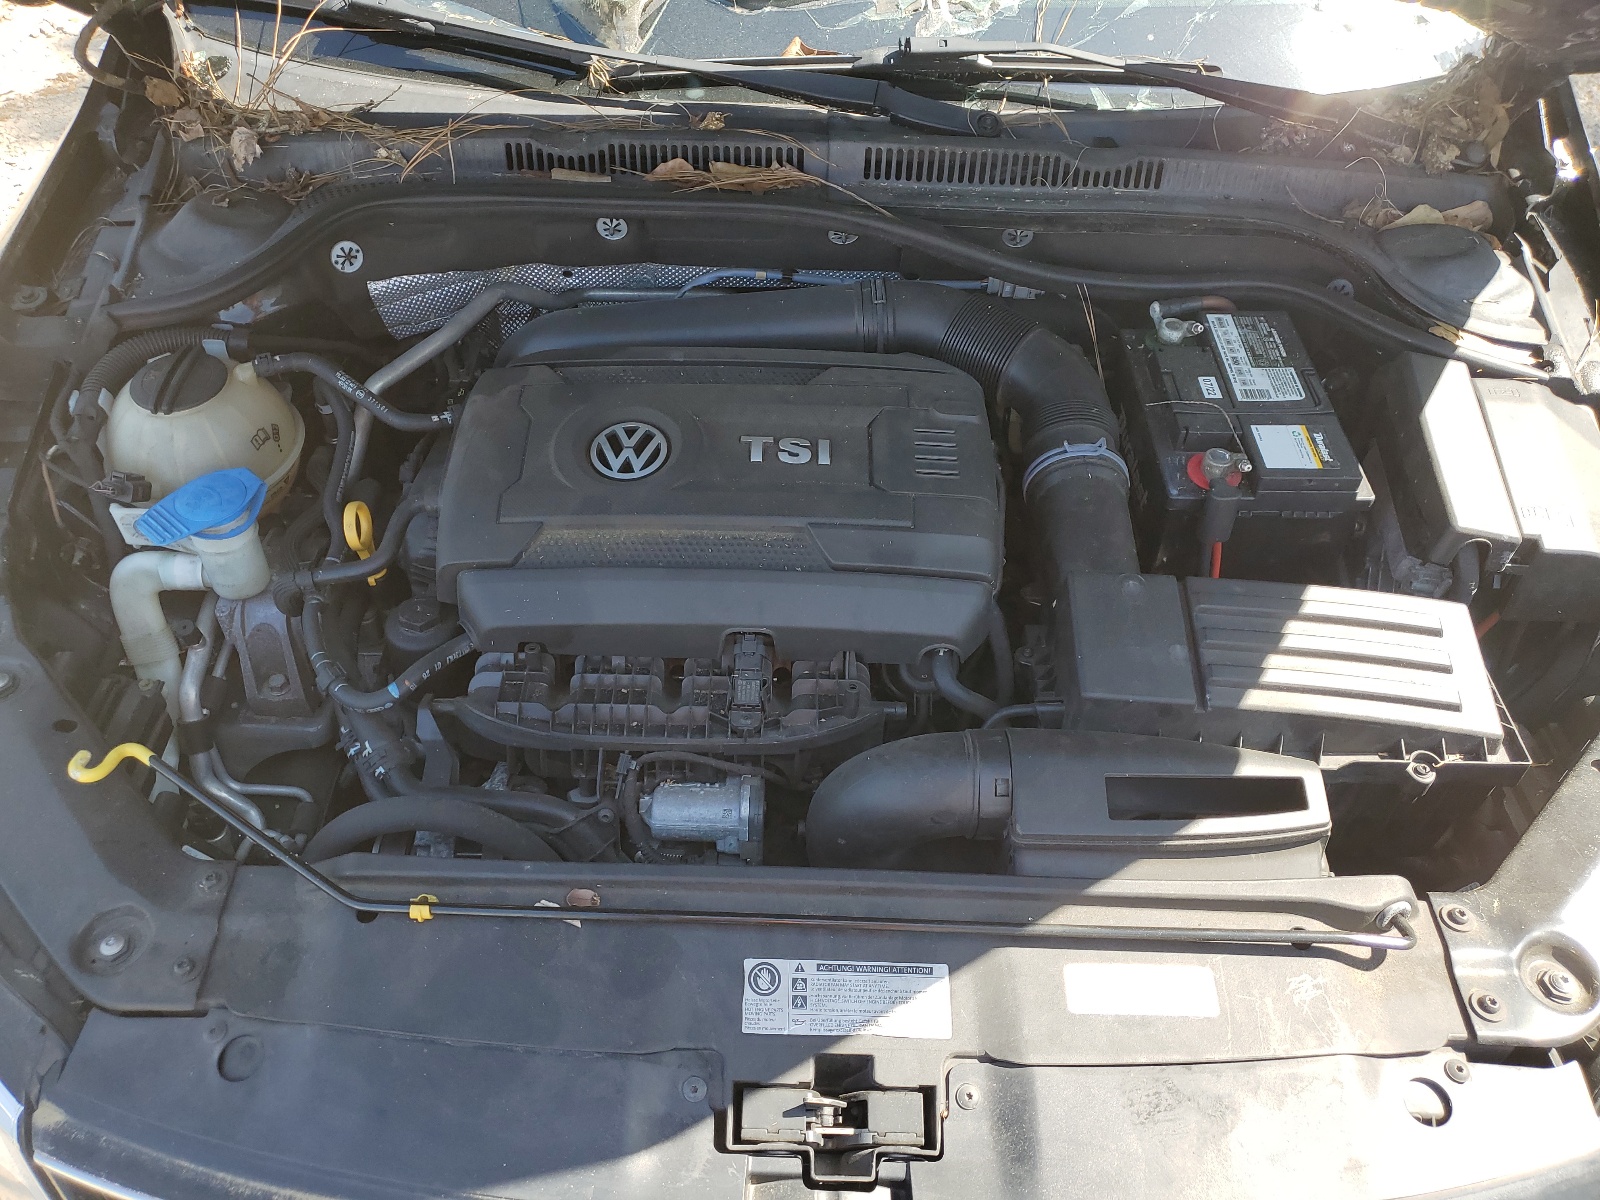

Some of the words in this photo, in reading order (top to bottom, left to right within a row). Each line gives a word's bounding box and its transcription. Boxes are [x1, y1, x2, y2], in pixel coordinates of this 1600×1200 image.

[1202, 378, 1217, 396] 07/22
[740, 435, 831, 466] TSI
[1313, 431, 1334, 462] Duralast
[818, 964, 855, 972] ACHTUNG!
[856, 965, 891, 973] WARNING!
[892, 966, 931, 974] ATTENTION!
